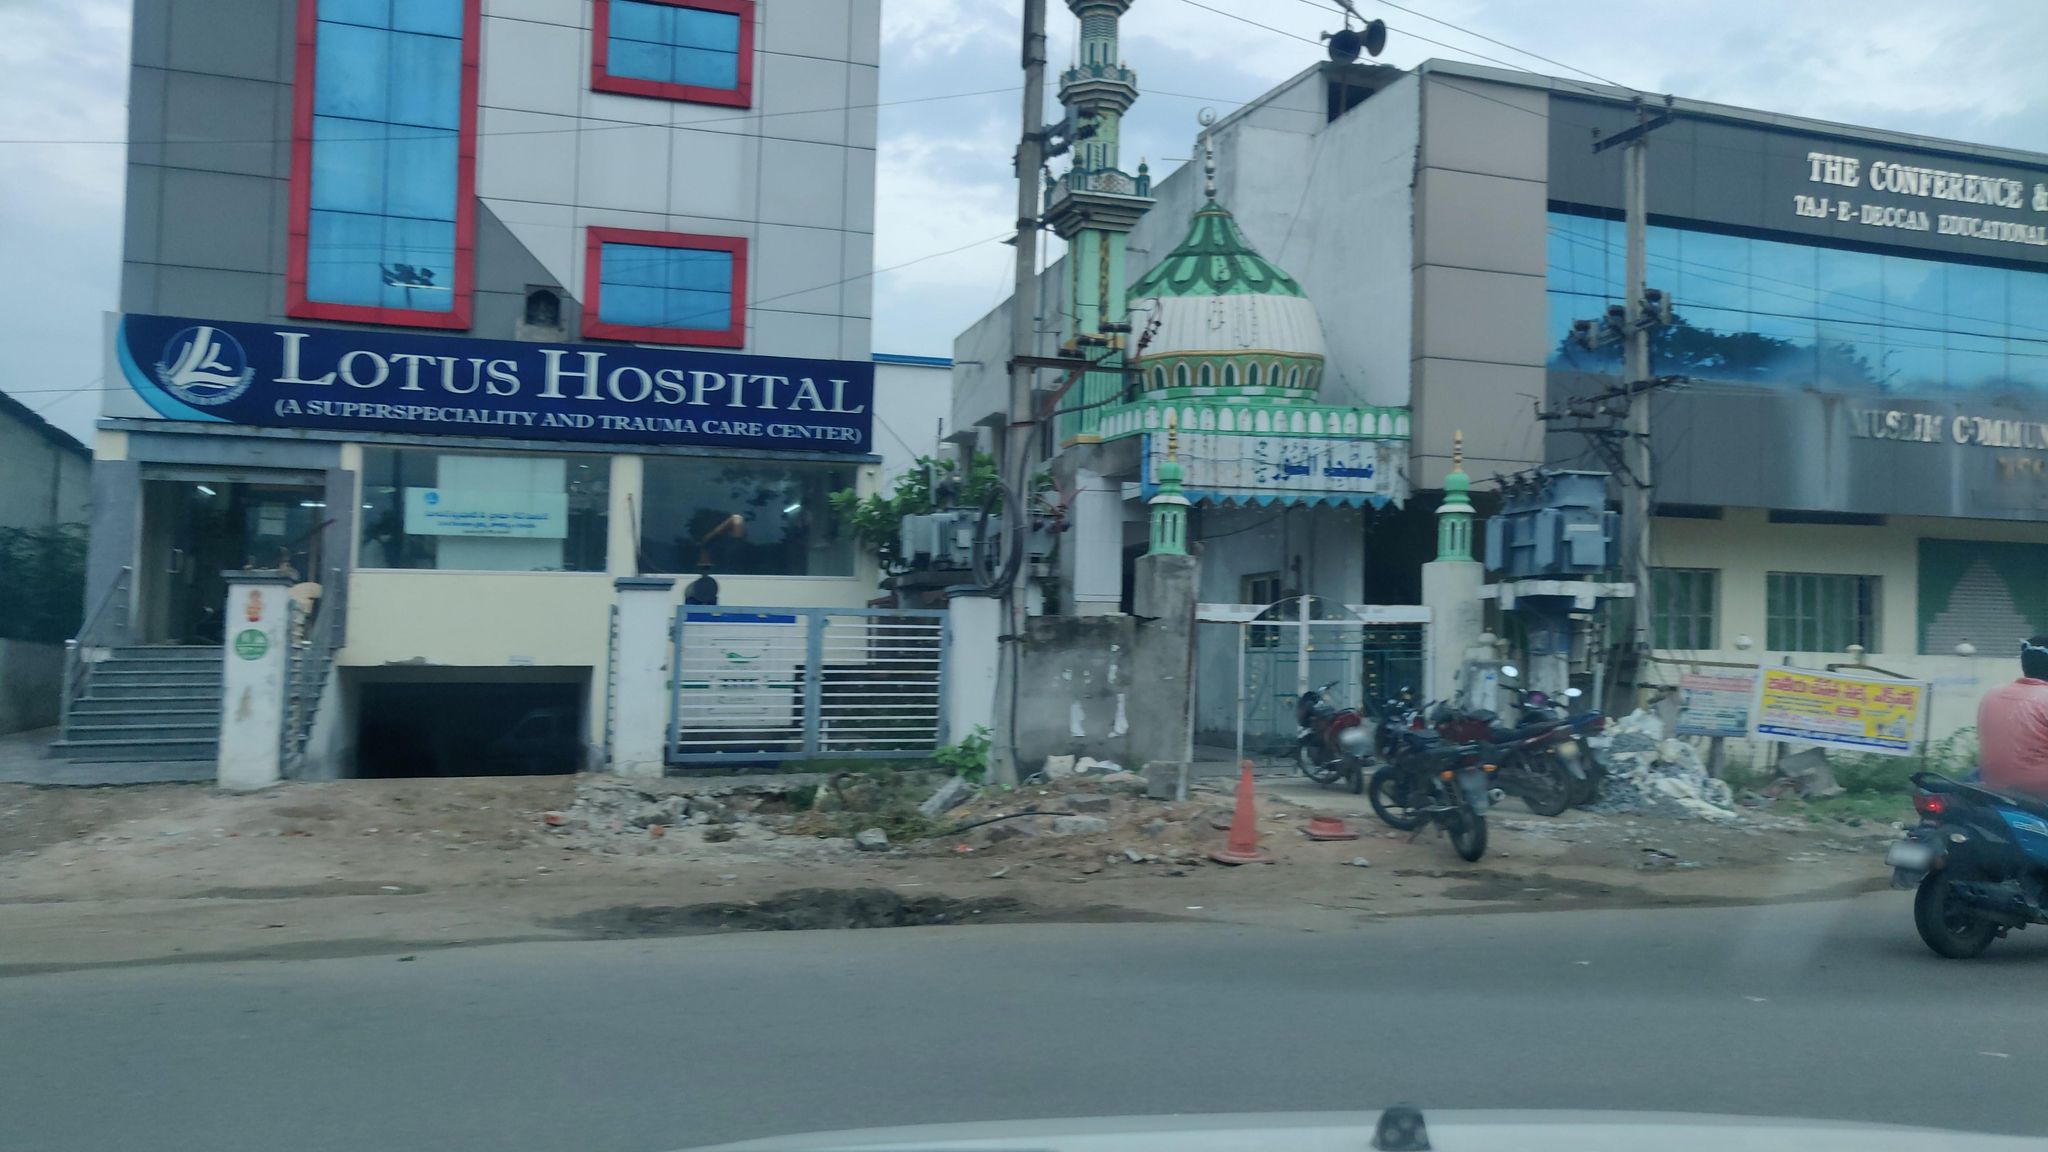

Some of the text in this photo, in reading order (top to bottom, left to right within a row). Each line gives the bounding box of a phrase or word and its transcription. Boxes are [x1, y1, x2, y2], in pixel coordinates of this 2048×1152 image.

[1807, 152, 1860, 188] THE
[1869, 160, 2024, 209] CONFERENCE
[1937, 213, 2048, 246] EDUCATIONAL
[272, 331, 865, 413] LOTUS HOSPITAL
[274, 399, 862, 445] (A SUPERSPECIALITY AND TRAUMA CARE CENTER)
